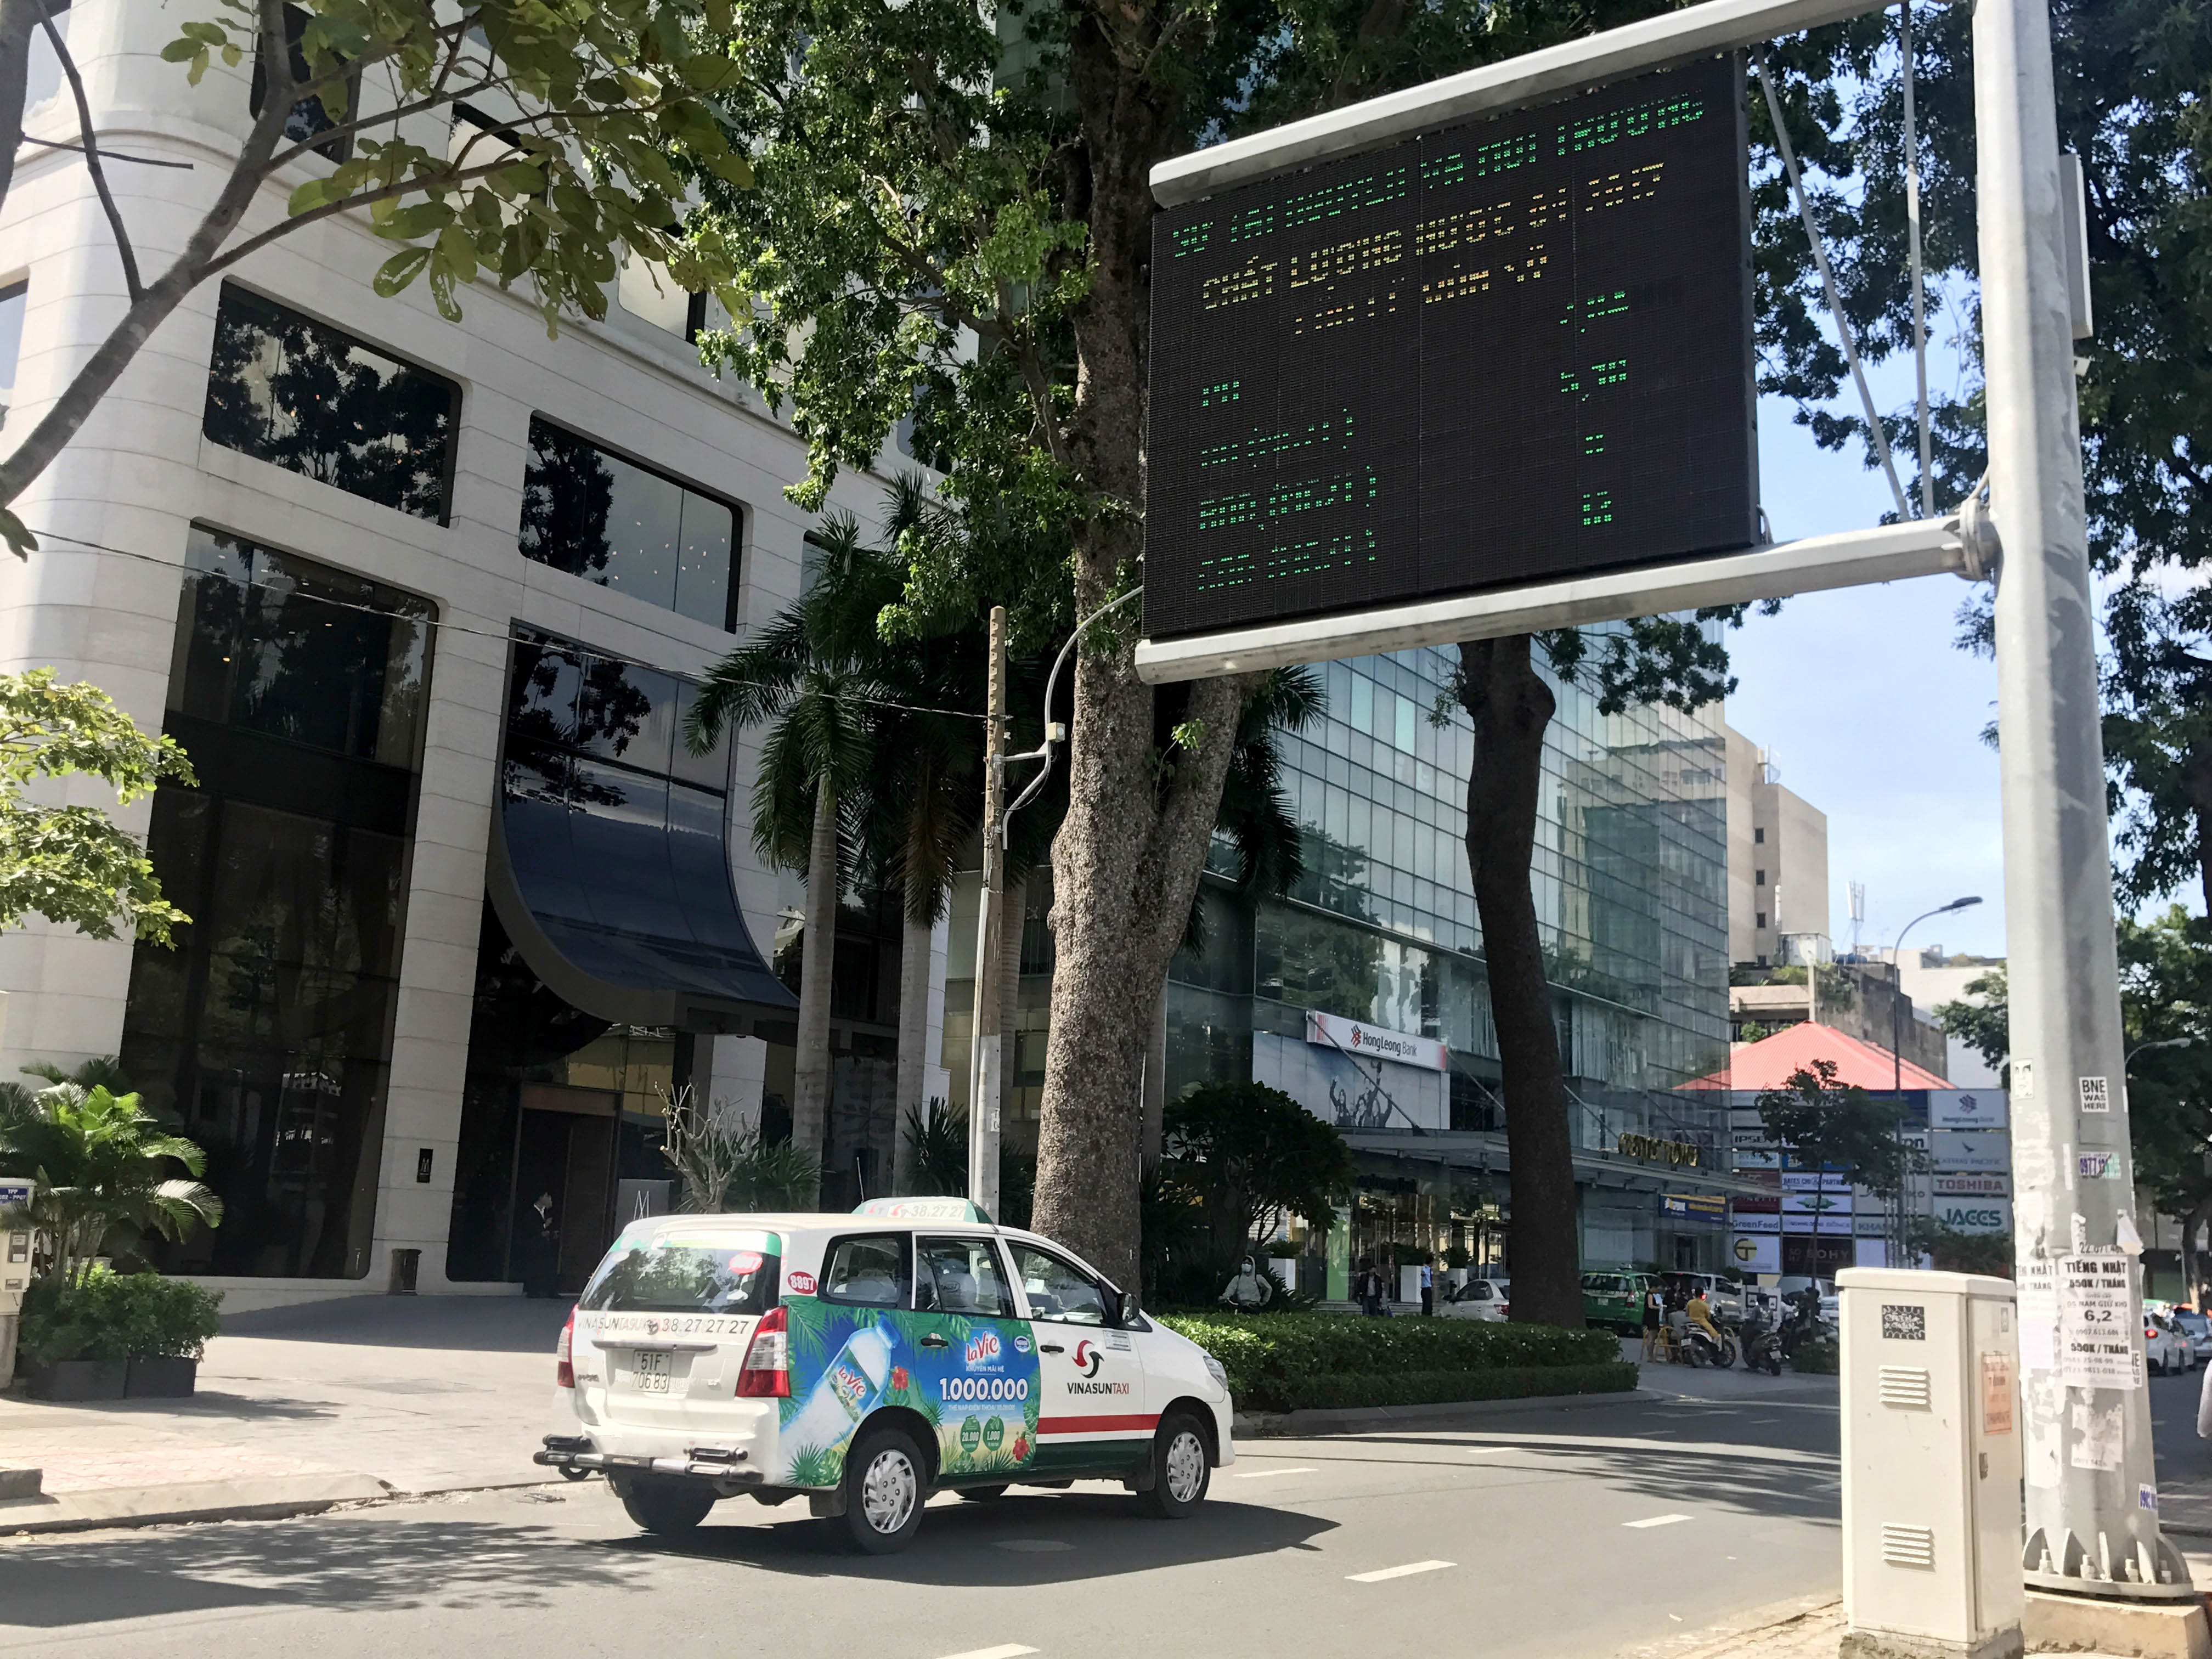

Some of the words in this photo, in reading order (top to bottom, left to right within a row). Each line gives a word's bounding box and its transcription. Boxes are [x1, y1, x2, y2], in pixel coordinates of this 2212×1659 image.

[1363, 1032, 1401, 1056] HongLeong
[1402, 1041, 1417, 1057] Bank
[2082, 1080, 2106, 1093] BNE
[1937, 1180, 2002, 1190] TOSHIBA
[1945, 1207, 2002, 1227] JACCS
[1733, 1220, 1779, 1229] GreenFeed
[789, 1275, 815, 1291] 8897
[2085, 1310, 2112, 1324] 6,2
[729, 1321, 749, 1334] 27
[641, 1353, 662, 1370] 51F
[940, 1378, 1028, 1401] 1.000.000
[1067, 1383, 1129, 1394] VINASUNTAXI
